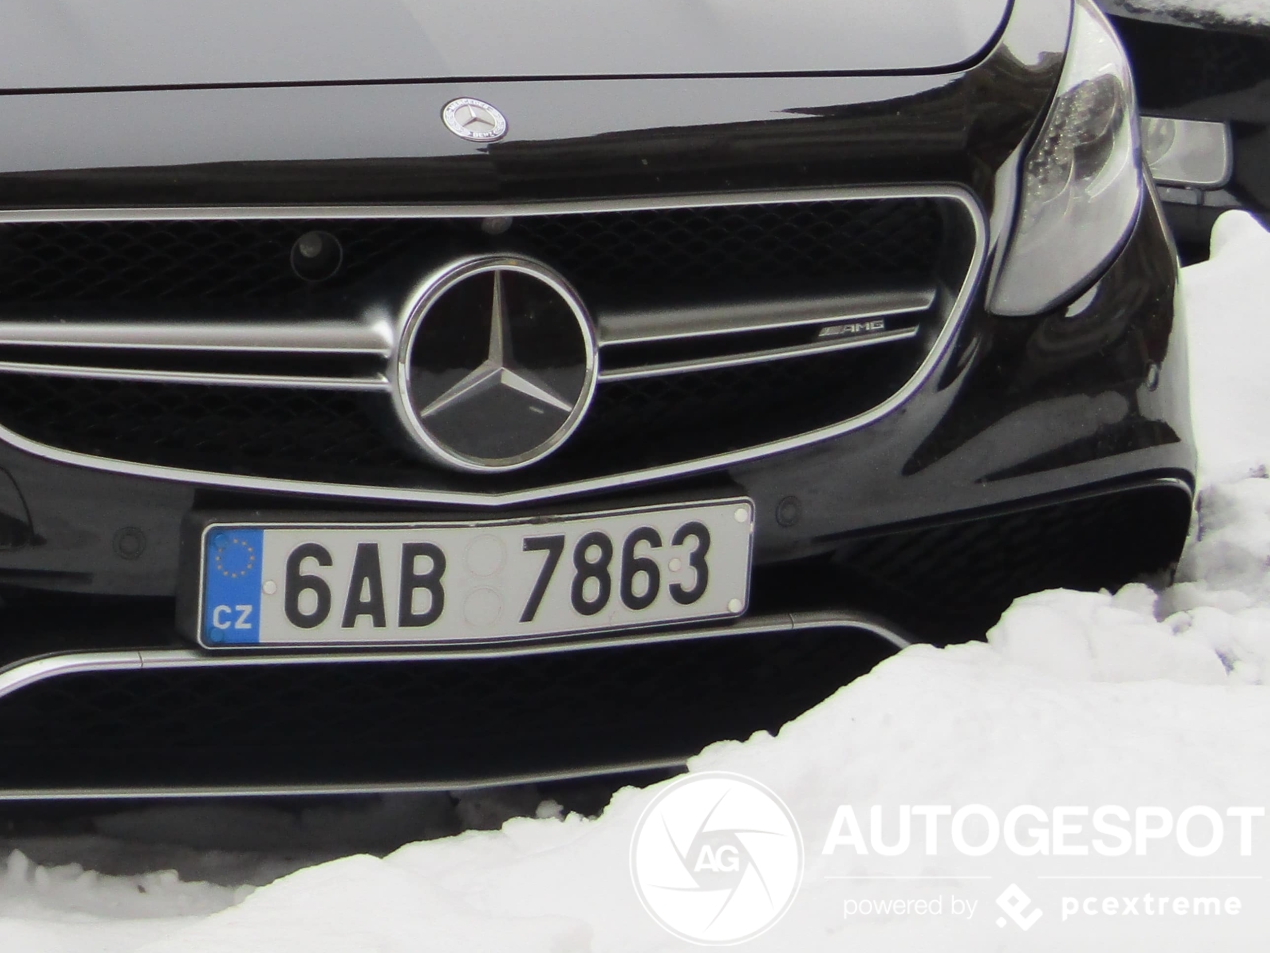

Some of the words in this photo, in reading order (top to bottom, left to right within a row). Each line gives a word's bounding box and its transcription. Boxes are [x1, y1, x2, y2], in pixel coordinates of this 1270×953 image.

[842, 320, 884, 332] AMG
[282, 540, 445, 628] 6AB
[520, 522, 710, 623] 7863
[212, 604, 253, 630] CZ
